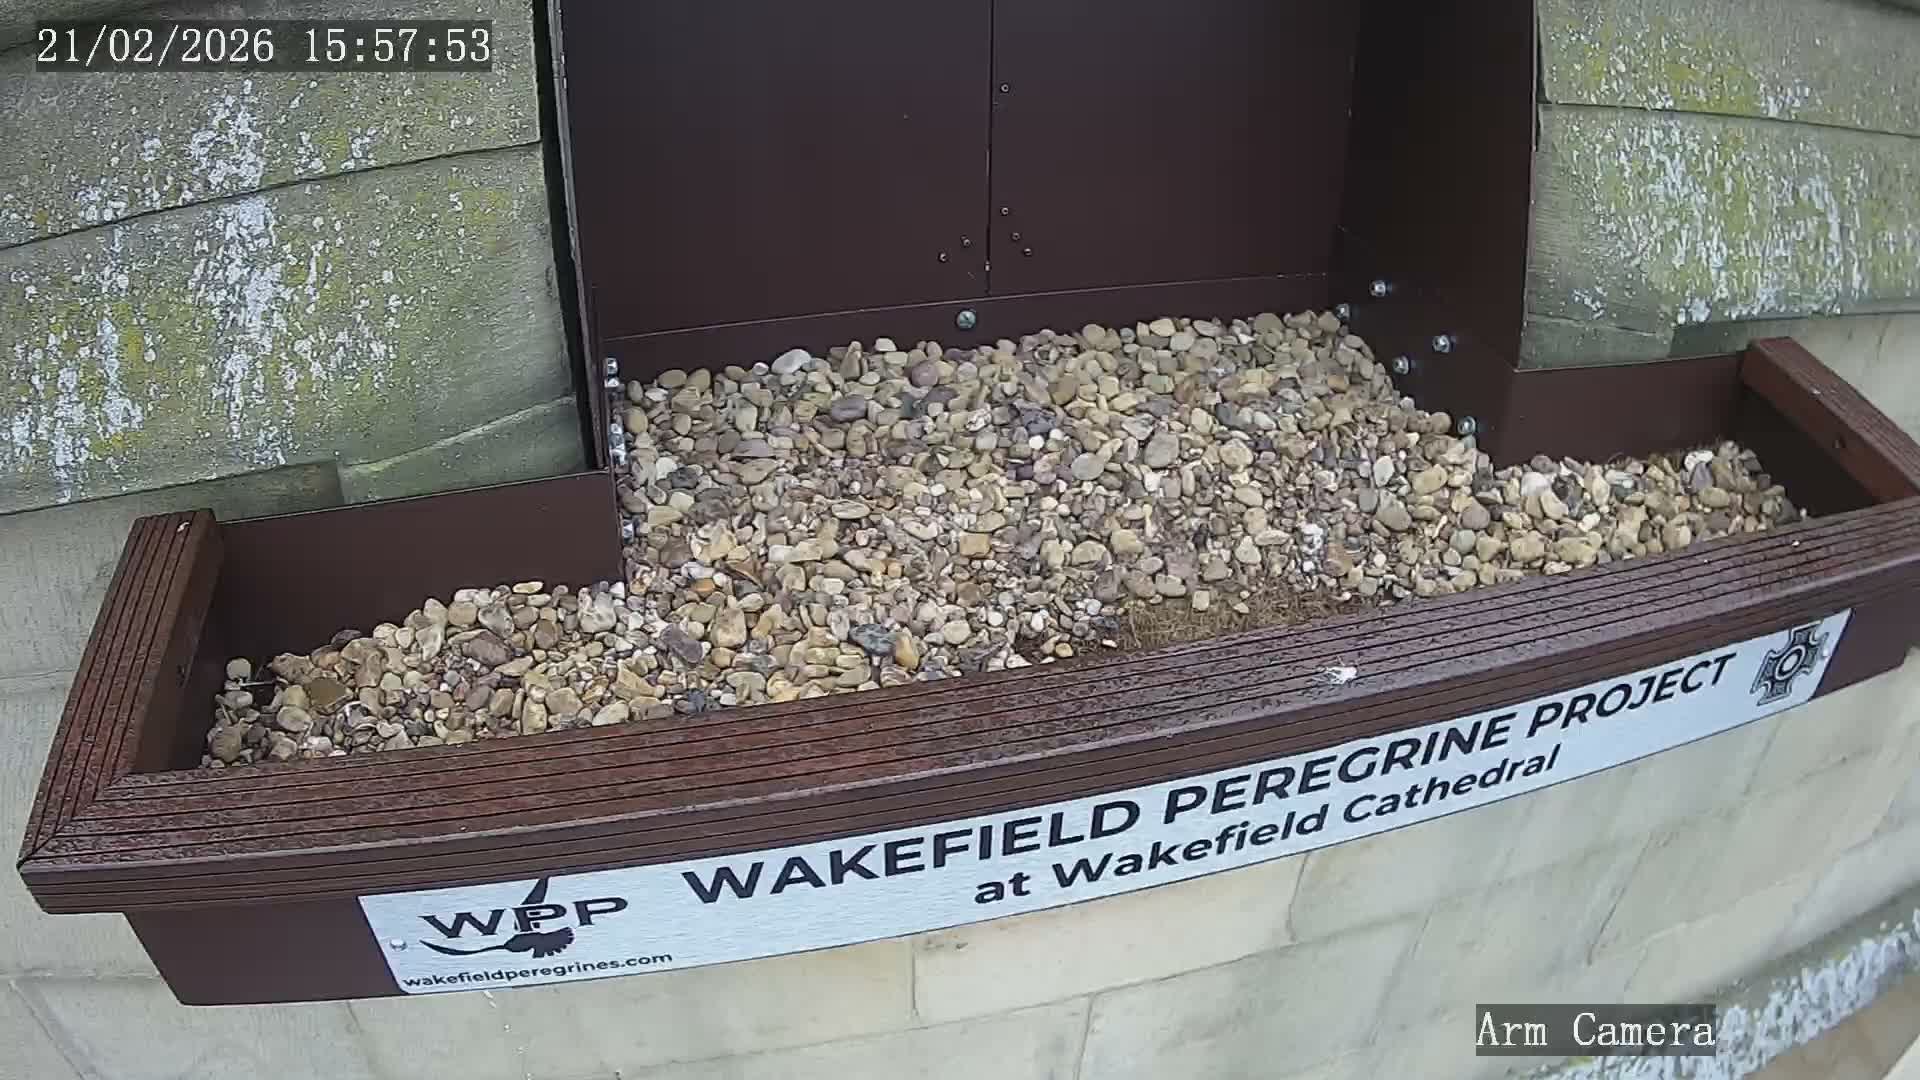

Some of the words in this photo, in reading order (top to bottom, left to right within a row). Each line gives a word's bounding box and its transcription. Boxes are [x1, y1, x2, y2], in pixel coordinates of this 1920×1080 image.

[682, 799, 1141, 904] WAKEFIELD
[1163, 712, 1518, 824] PEREGRINE
[1526, 653, 1737, 738] PROJECT
[974, 871, 1031, 904] at
[1051, 804, 1329, 885] Wakefield
[1343, 744, 1562, 824] Cathedral
[418, 897, 629, 938] WPP
[402, 953, 673, 988] wakefieldperegrines.com
